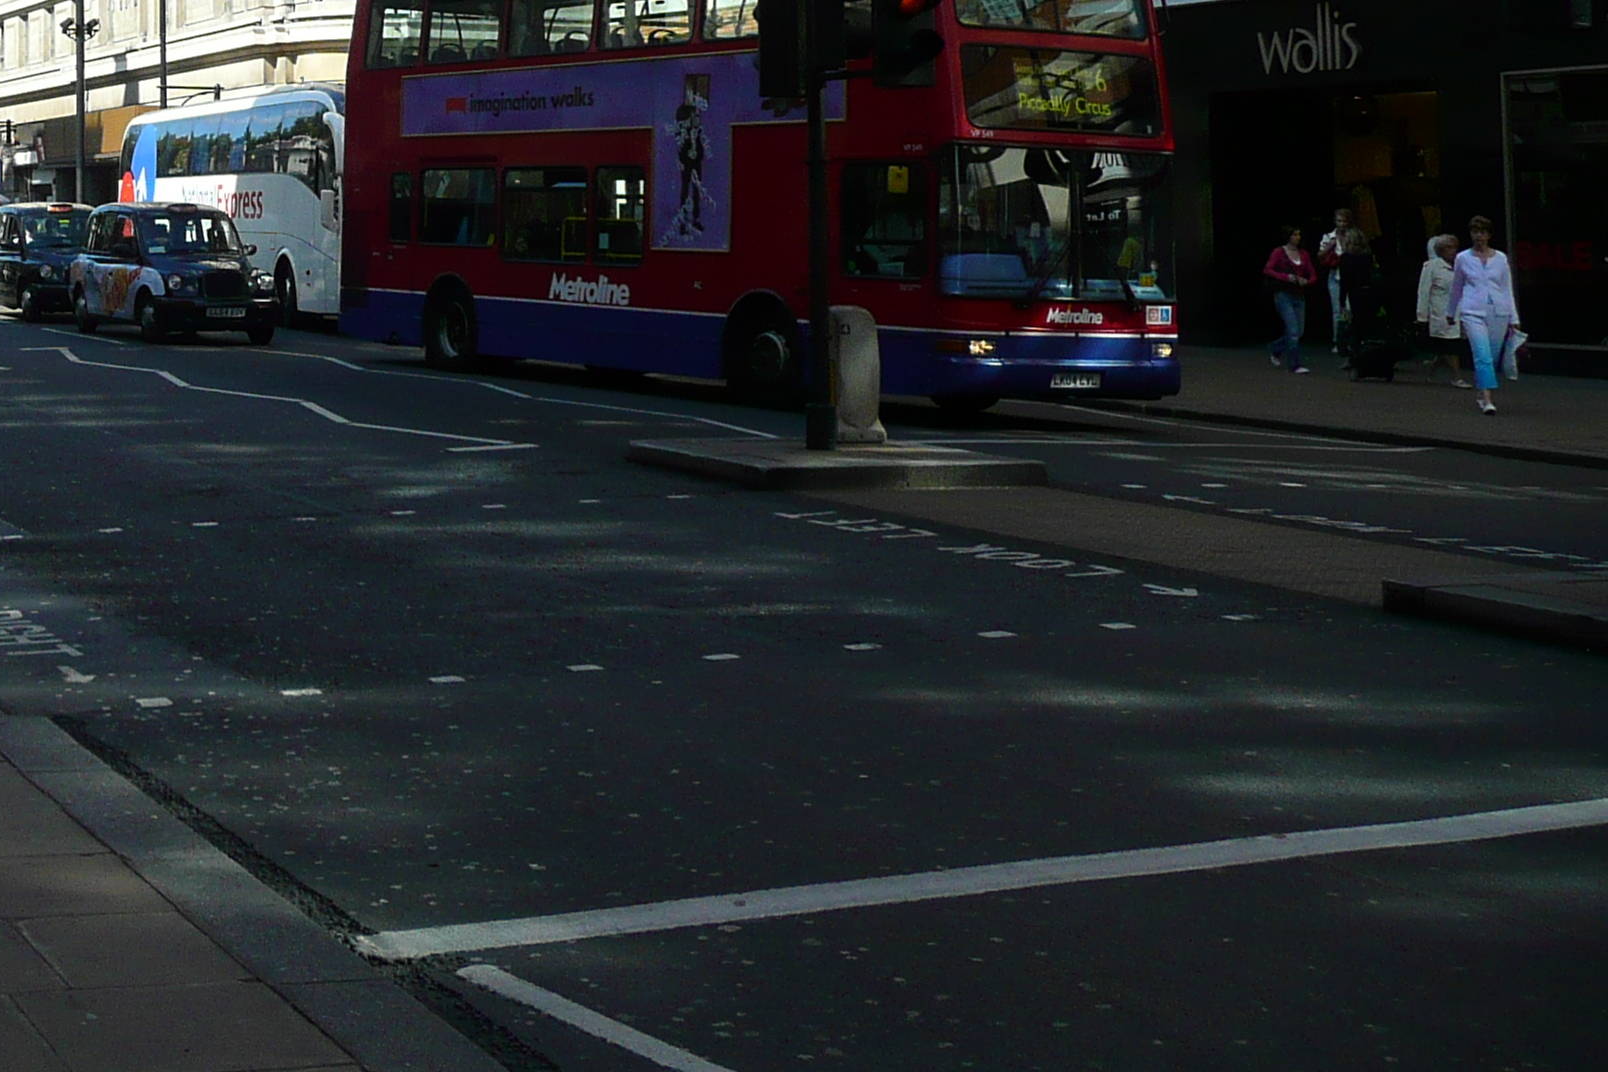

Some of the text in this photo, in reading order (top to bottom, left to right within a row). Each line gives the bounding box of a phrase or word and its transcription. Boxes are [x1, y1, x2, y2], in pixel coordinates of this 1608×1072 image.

[1095, 66, 1108, 92] 6
[469, 86, 594, 117] imagination walks
[1018, 92, 1111, 117] Piccadilly Circus
[217, 184, 264, 220] Express
[548, 271, 631, 306] Metroline
[1045, 307, 1103, 325] Metroline
